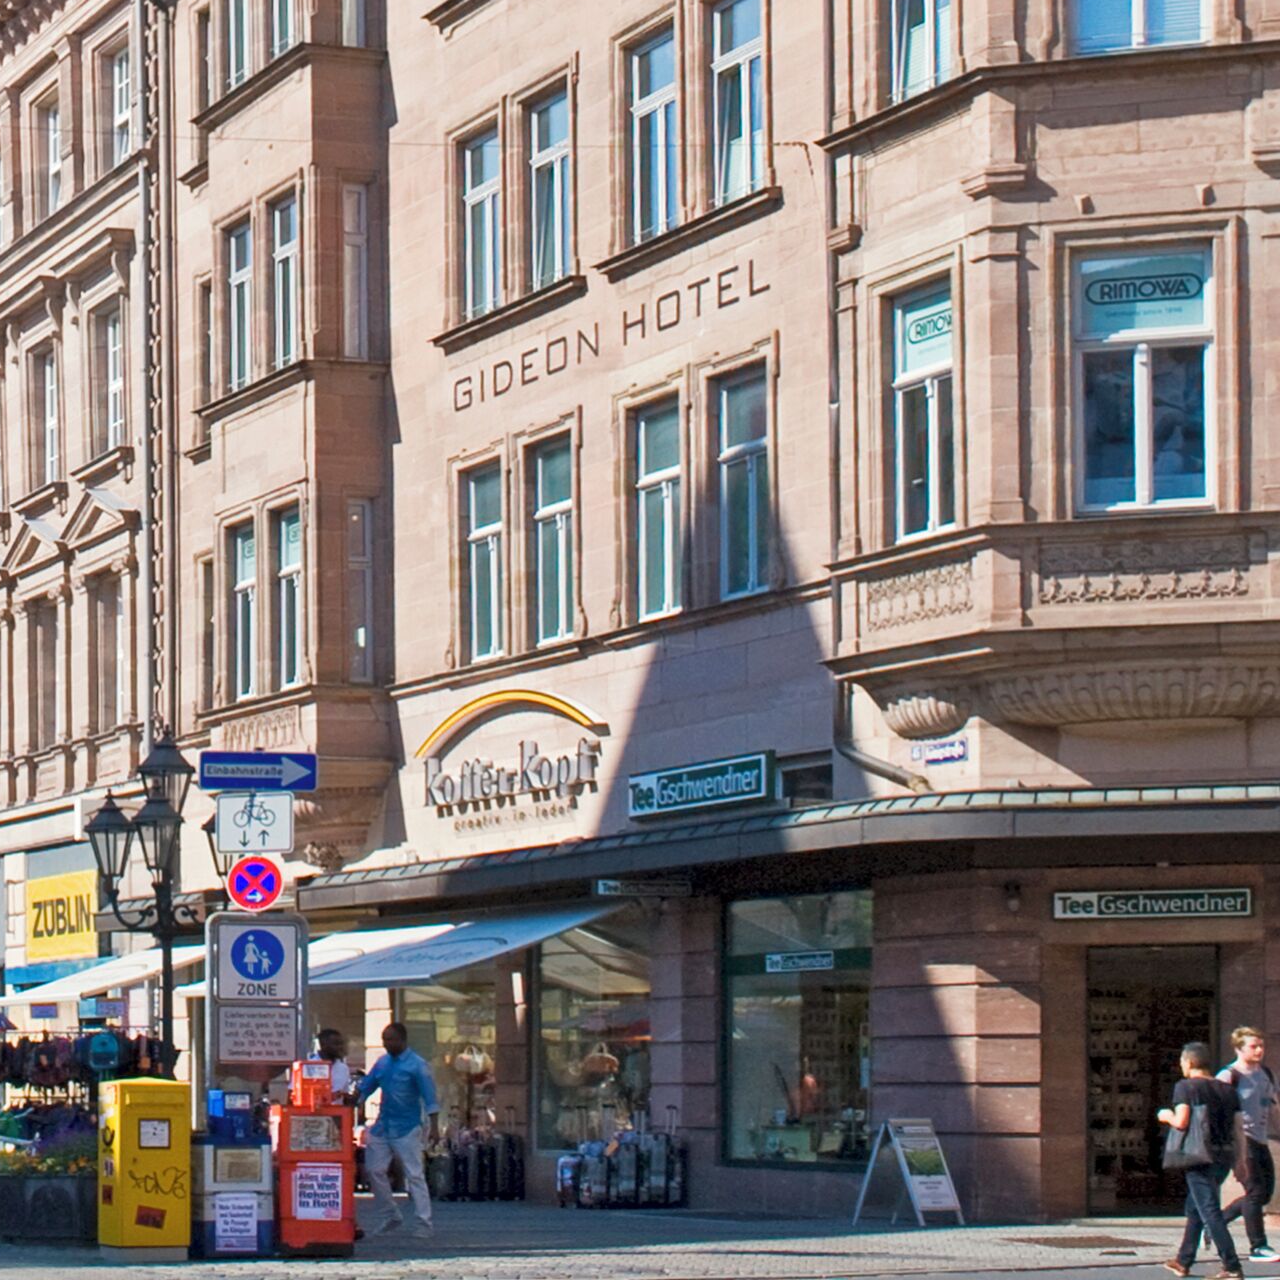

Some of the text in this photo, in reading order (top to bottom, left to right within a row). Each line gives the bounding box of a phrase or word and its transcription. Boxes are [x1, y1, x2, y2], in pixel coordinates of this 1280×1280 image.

[1100, 280, 1190, 300] RIMOWA
[453, 259, 771, 412] GIDEON HOTEL
[206, 765, 284, 776] Einbahnstraße
[629, 765, 759, 812] Tee Gschwendner
[1057, 893, 1245, 915] Tee Gschwendner
[32, 892, 91, 939] ZÜBLIN
[237, 983, 277, 996] ZONE
[299, 1173, 339, 1183] Alles über
[299, 1182, 314, 1190] den
[299, 1190, 339, 1200] Rekord
[313, 1199, 339, 1209] Roth
